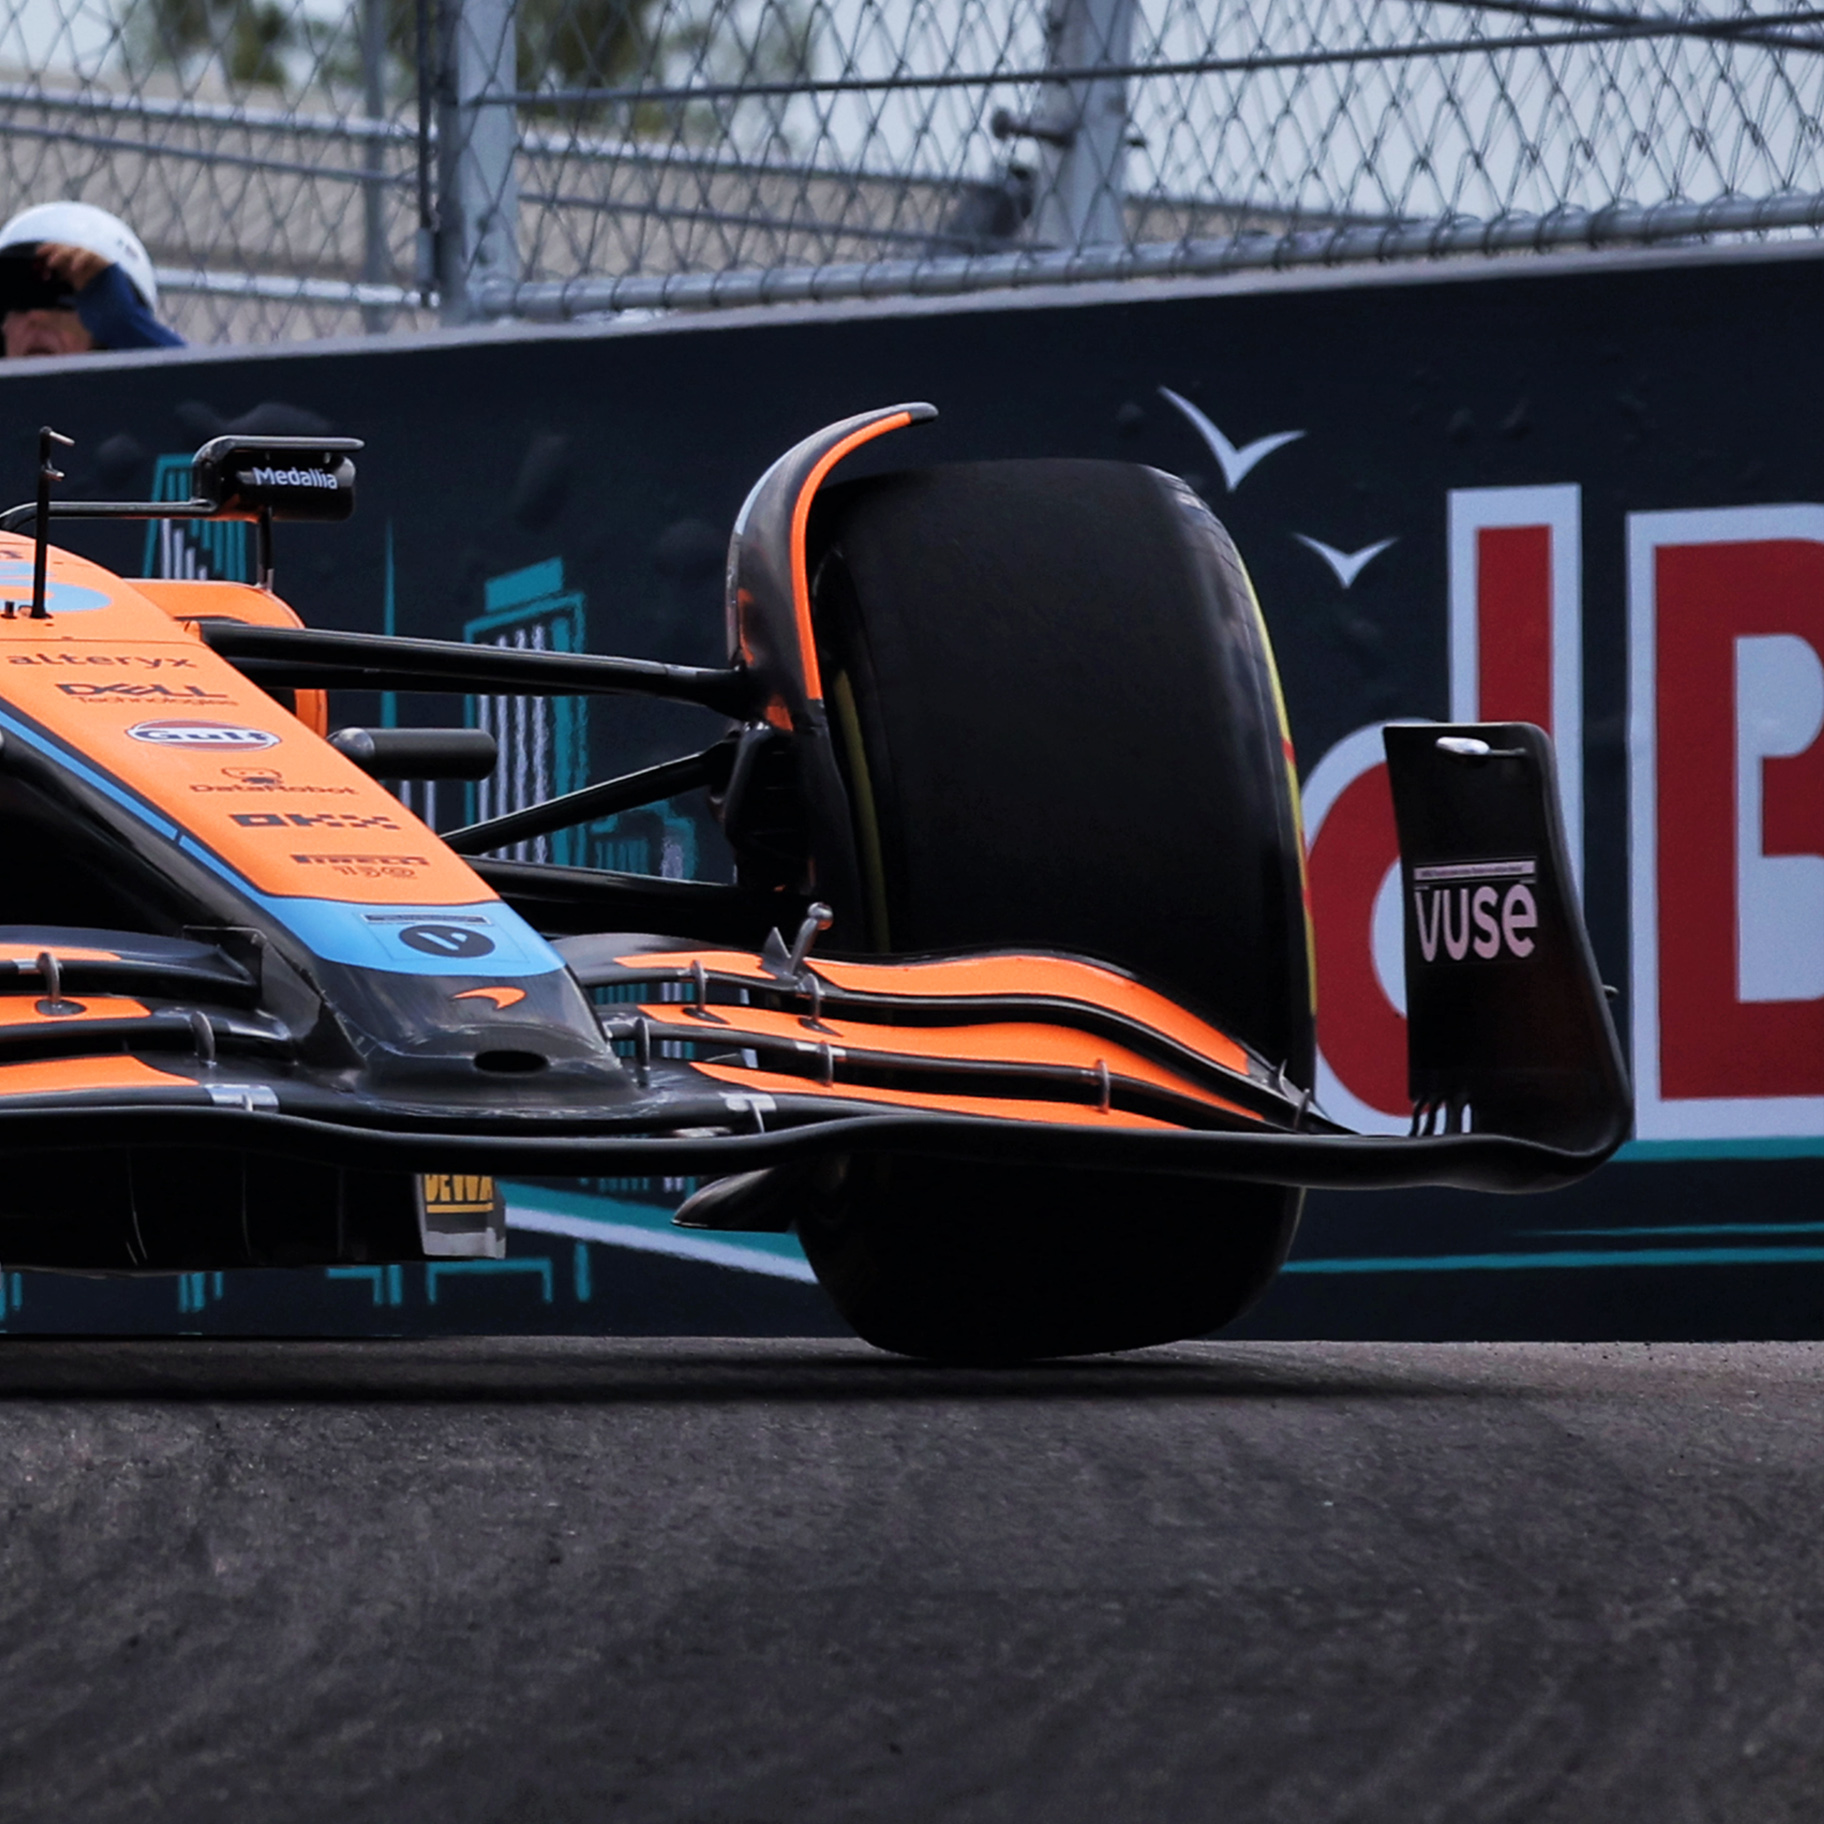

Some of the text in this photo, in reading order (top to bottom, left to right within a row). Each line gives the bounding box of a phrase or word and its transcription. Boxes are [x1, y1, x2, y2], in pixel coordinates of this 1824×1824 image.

[253, 467, 338, 490] Medallia
[7, 653, 198, 669] alteryx
[55, 683, 229, 698] DELL
[134, 728, 271, 741] Gulf
[190, 784, 360, 795] DataRobot
[228, 813, 401, 830] OKX
